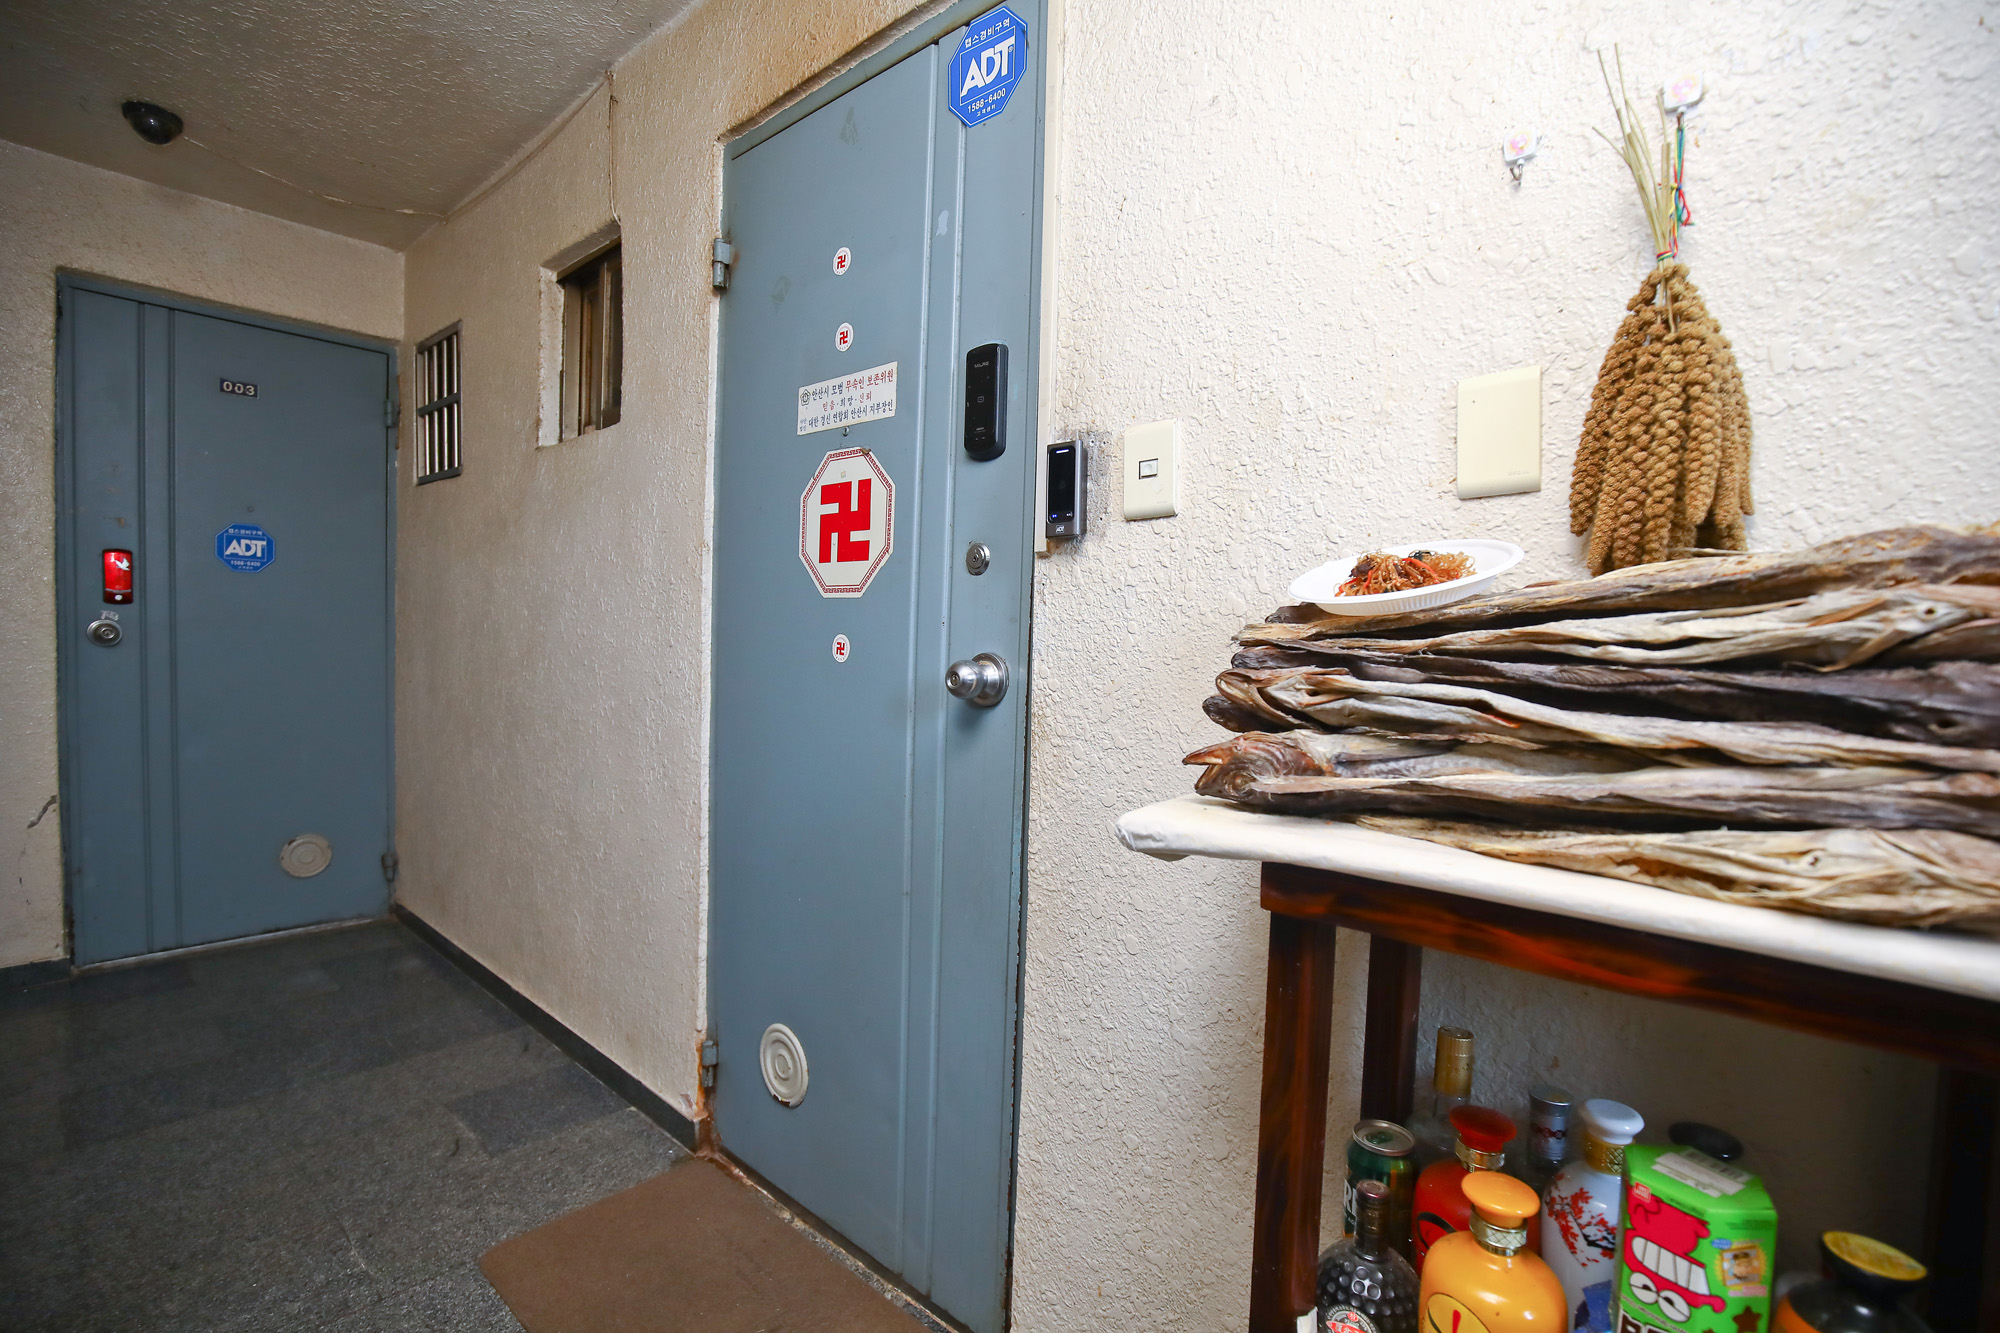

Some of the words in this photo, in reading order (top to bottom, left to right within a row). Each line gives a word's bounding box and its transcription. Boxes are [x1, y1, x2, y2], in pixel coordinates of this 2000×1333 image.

[960, 36, 1015, 97] ADT
[967, 88, 1006, 113] 1588-6400
[223, 381, 255, 396] 003
[811, 385, 829, 401] 안산시
[831, 381, 844, 396] 모범
[845, 376, 865, 393] 무속인
[850, 405, 868, 420] 안산시
[224, 538, 267, 558] ADT
